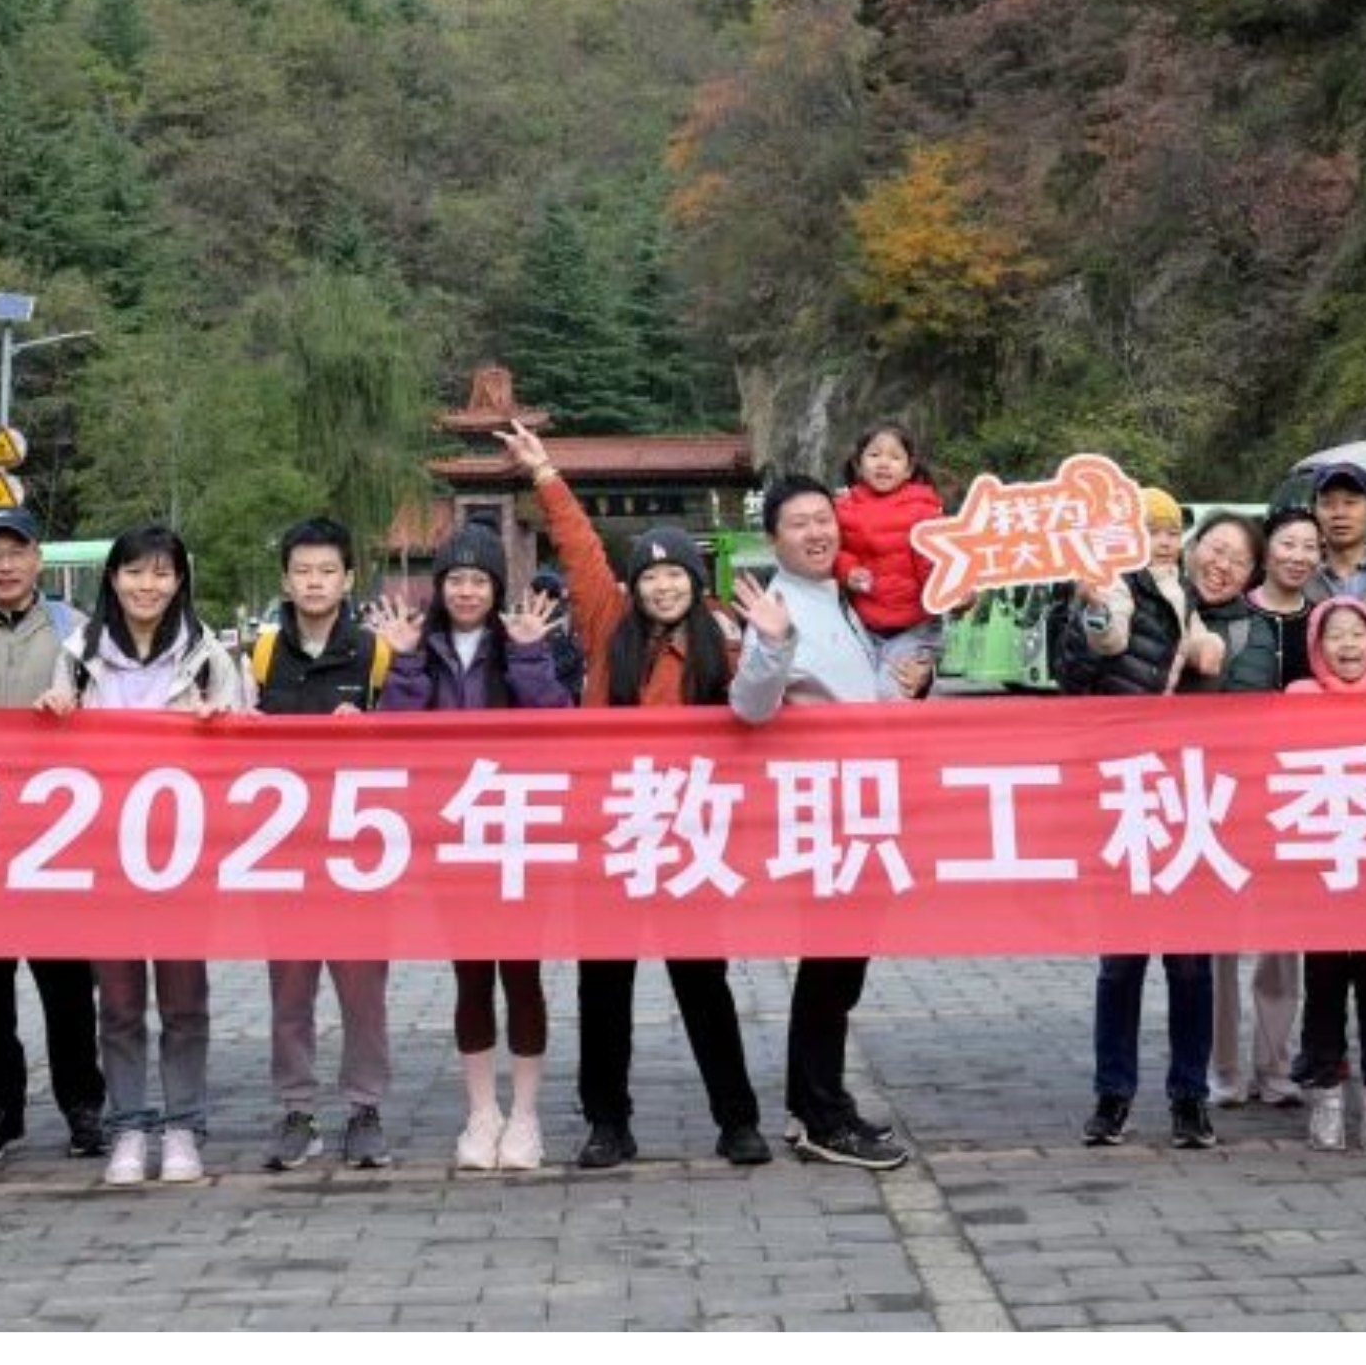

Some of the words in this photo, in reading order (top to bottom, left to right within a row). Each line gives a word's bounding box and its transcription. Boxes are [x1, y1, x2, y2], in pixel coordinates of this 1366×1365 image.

[990, 495, 1088, 535] 我为
[974, 524, 1138, 577] 工大代言
